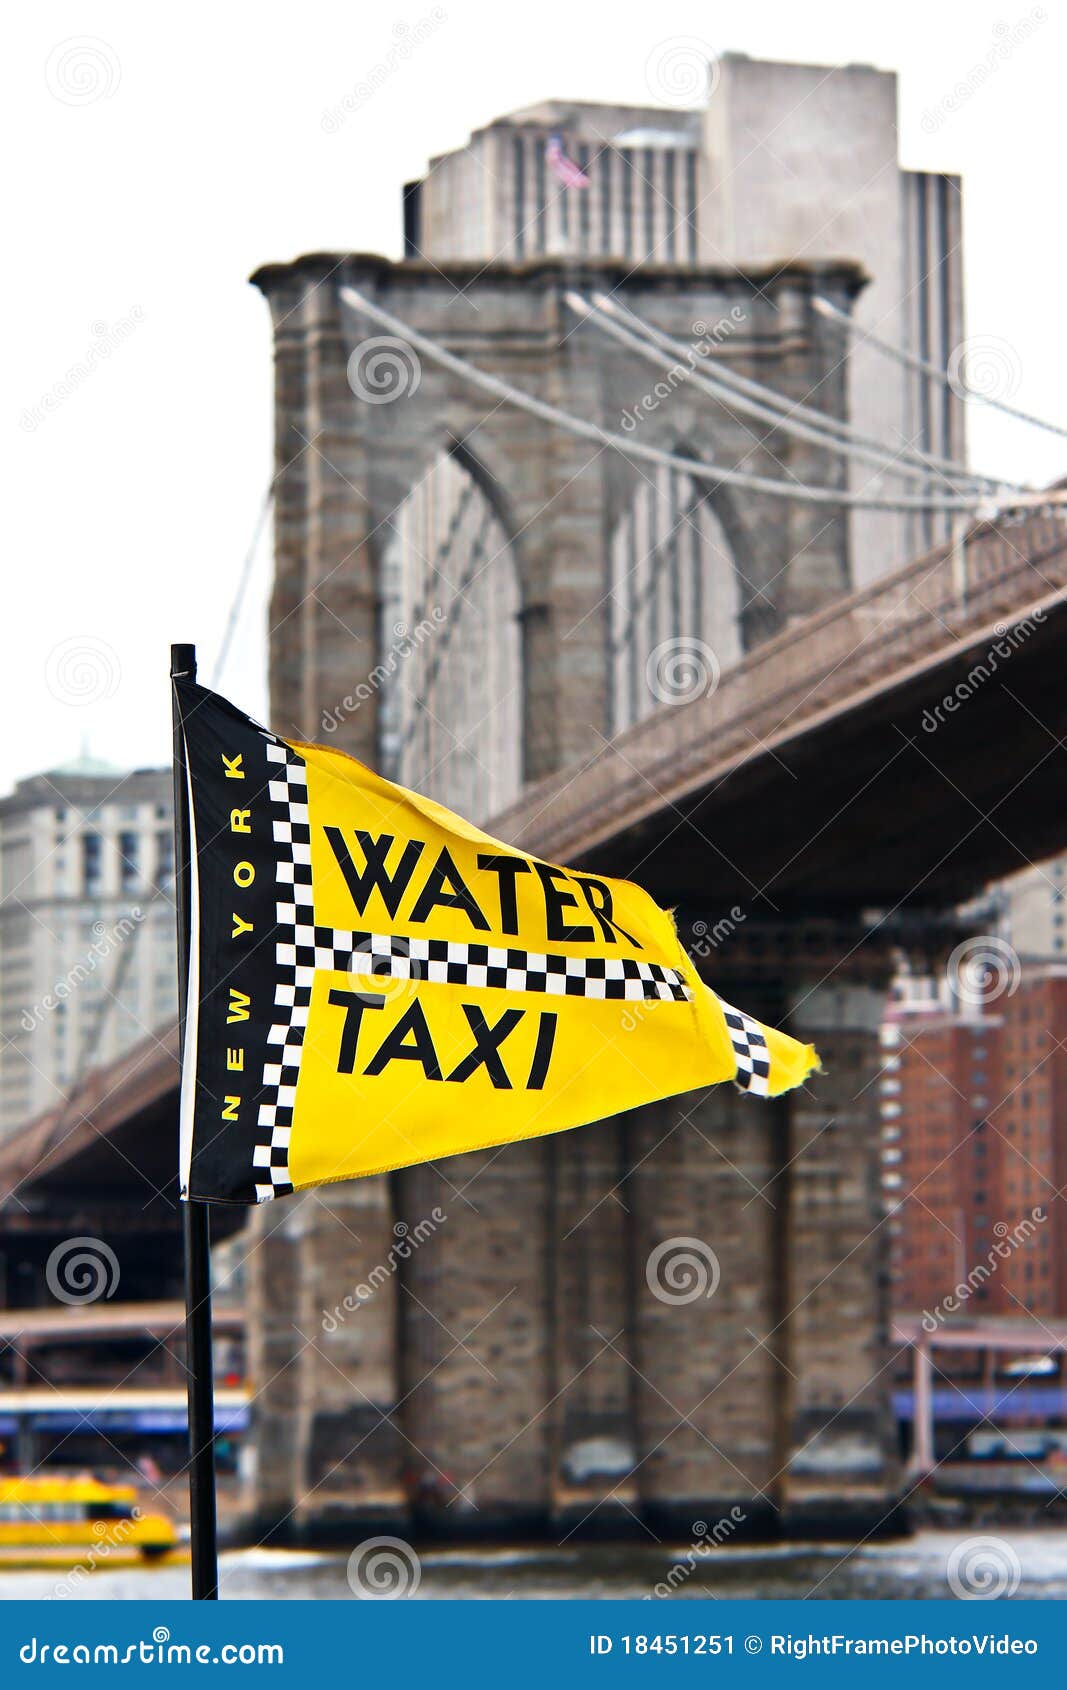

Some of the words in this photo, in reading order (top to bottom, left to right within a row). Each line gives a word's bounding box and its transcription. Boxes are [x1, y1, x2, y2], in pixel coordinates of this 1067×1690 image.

[222, 753, 255, 938] YORK
[323, 826, 644, 950] WATER
[222, 989, 252, 1121] NEW
[328, 989, 558, 1091] TAXI
